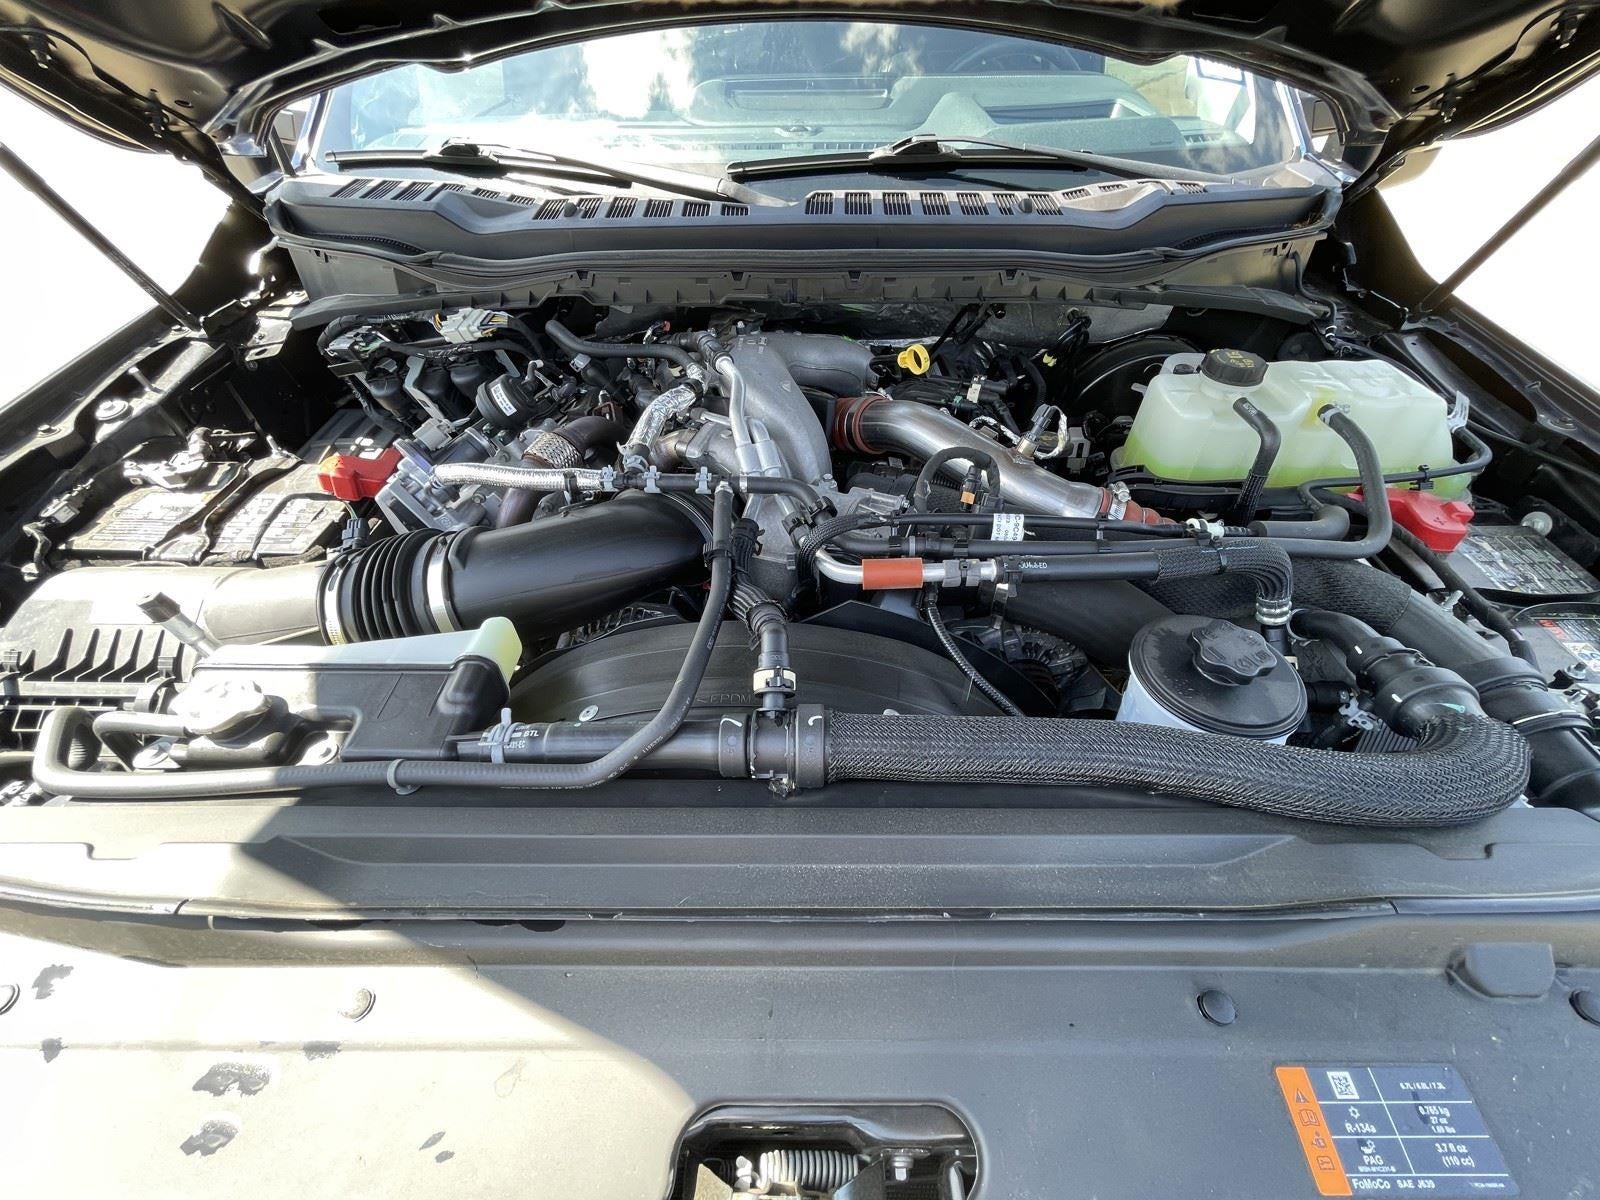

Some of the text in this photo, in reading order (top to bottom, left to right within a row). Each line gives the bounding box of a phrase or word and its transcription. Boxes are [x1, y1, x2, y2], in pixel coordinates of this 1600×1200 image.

[1438, 1105, 1450, 1117] kg
[1345, 1123, 1376, 1133] R-134a
[1435, 1143, 1468, 1152] 3.7 fl oz
[1363, 1155, 1383, 1165] PAG
[1442, 1155, 1475, 1168] (110 cc)
[1351, 1178, 1391, 1189] FoMoCo
[1396, 1179, 1415, 1189] SAE
